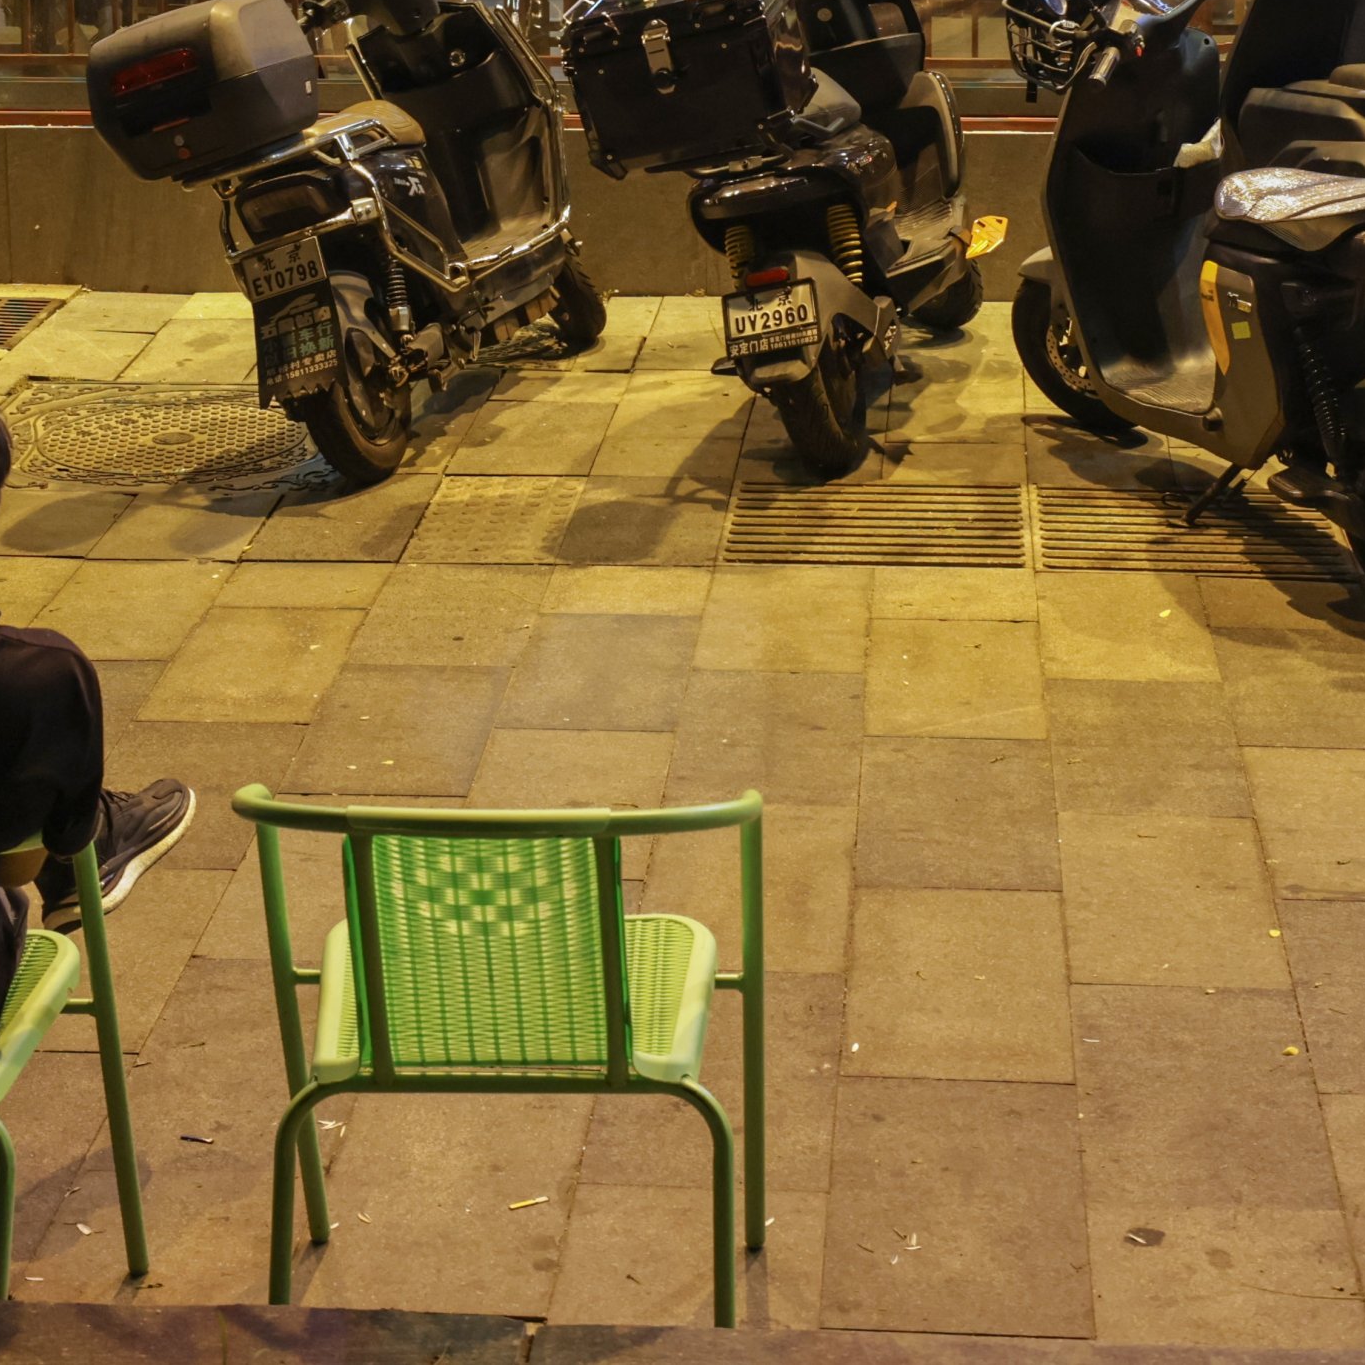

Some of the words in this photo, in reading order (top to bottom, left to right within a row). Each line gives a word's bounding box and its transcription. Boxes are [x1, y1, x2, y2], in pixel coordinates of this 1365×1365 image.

[263, 245, 302, 272] 北京
[252, 259, 320, 298] EY0798
[747, 289, 794, 313] 北京
[734, 303, 809, 334] UV2960
[730, 338, 770, 357] 安定门店
